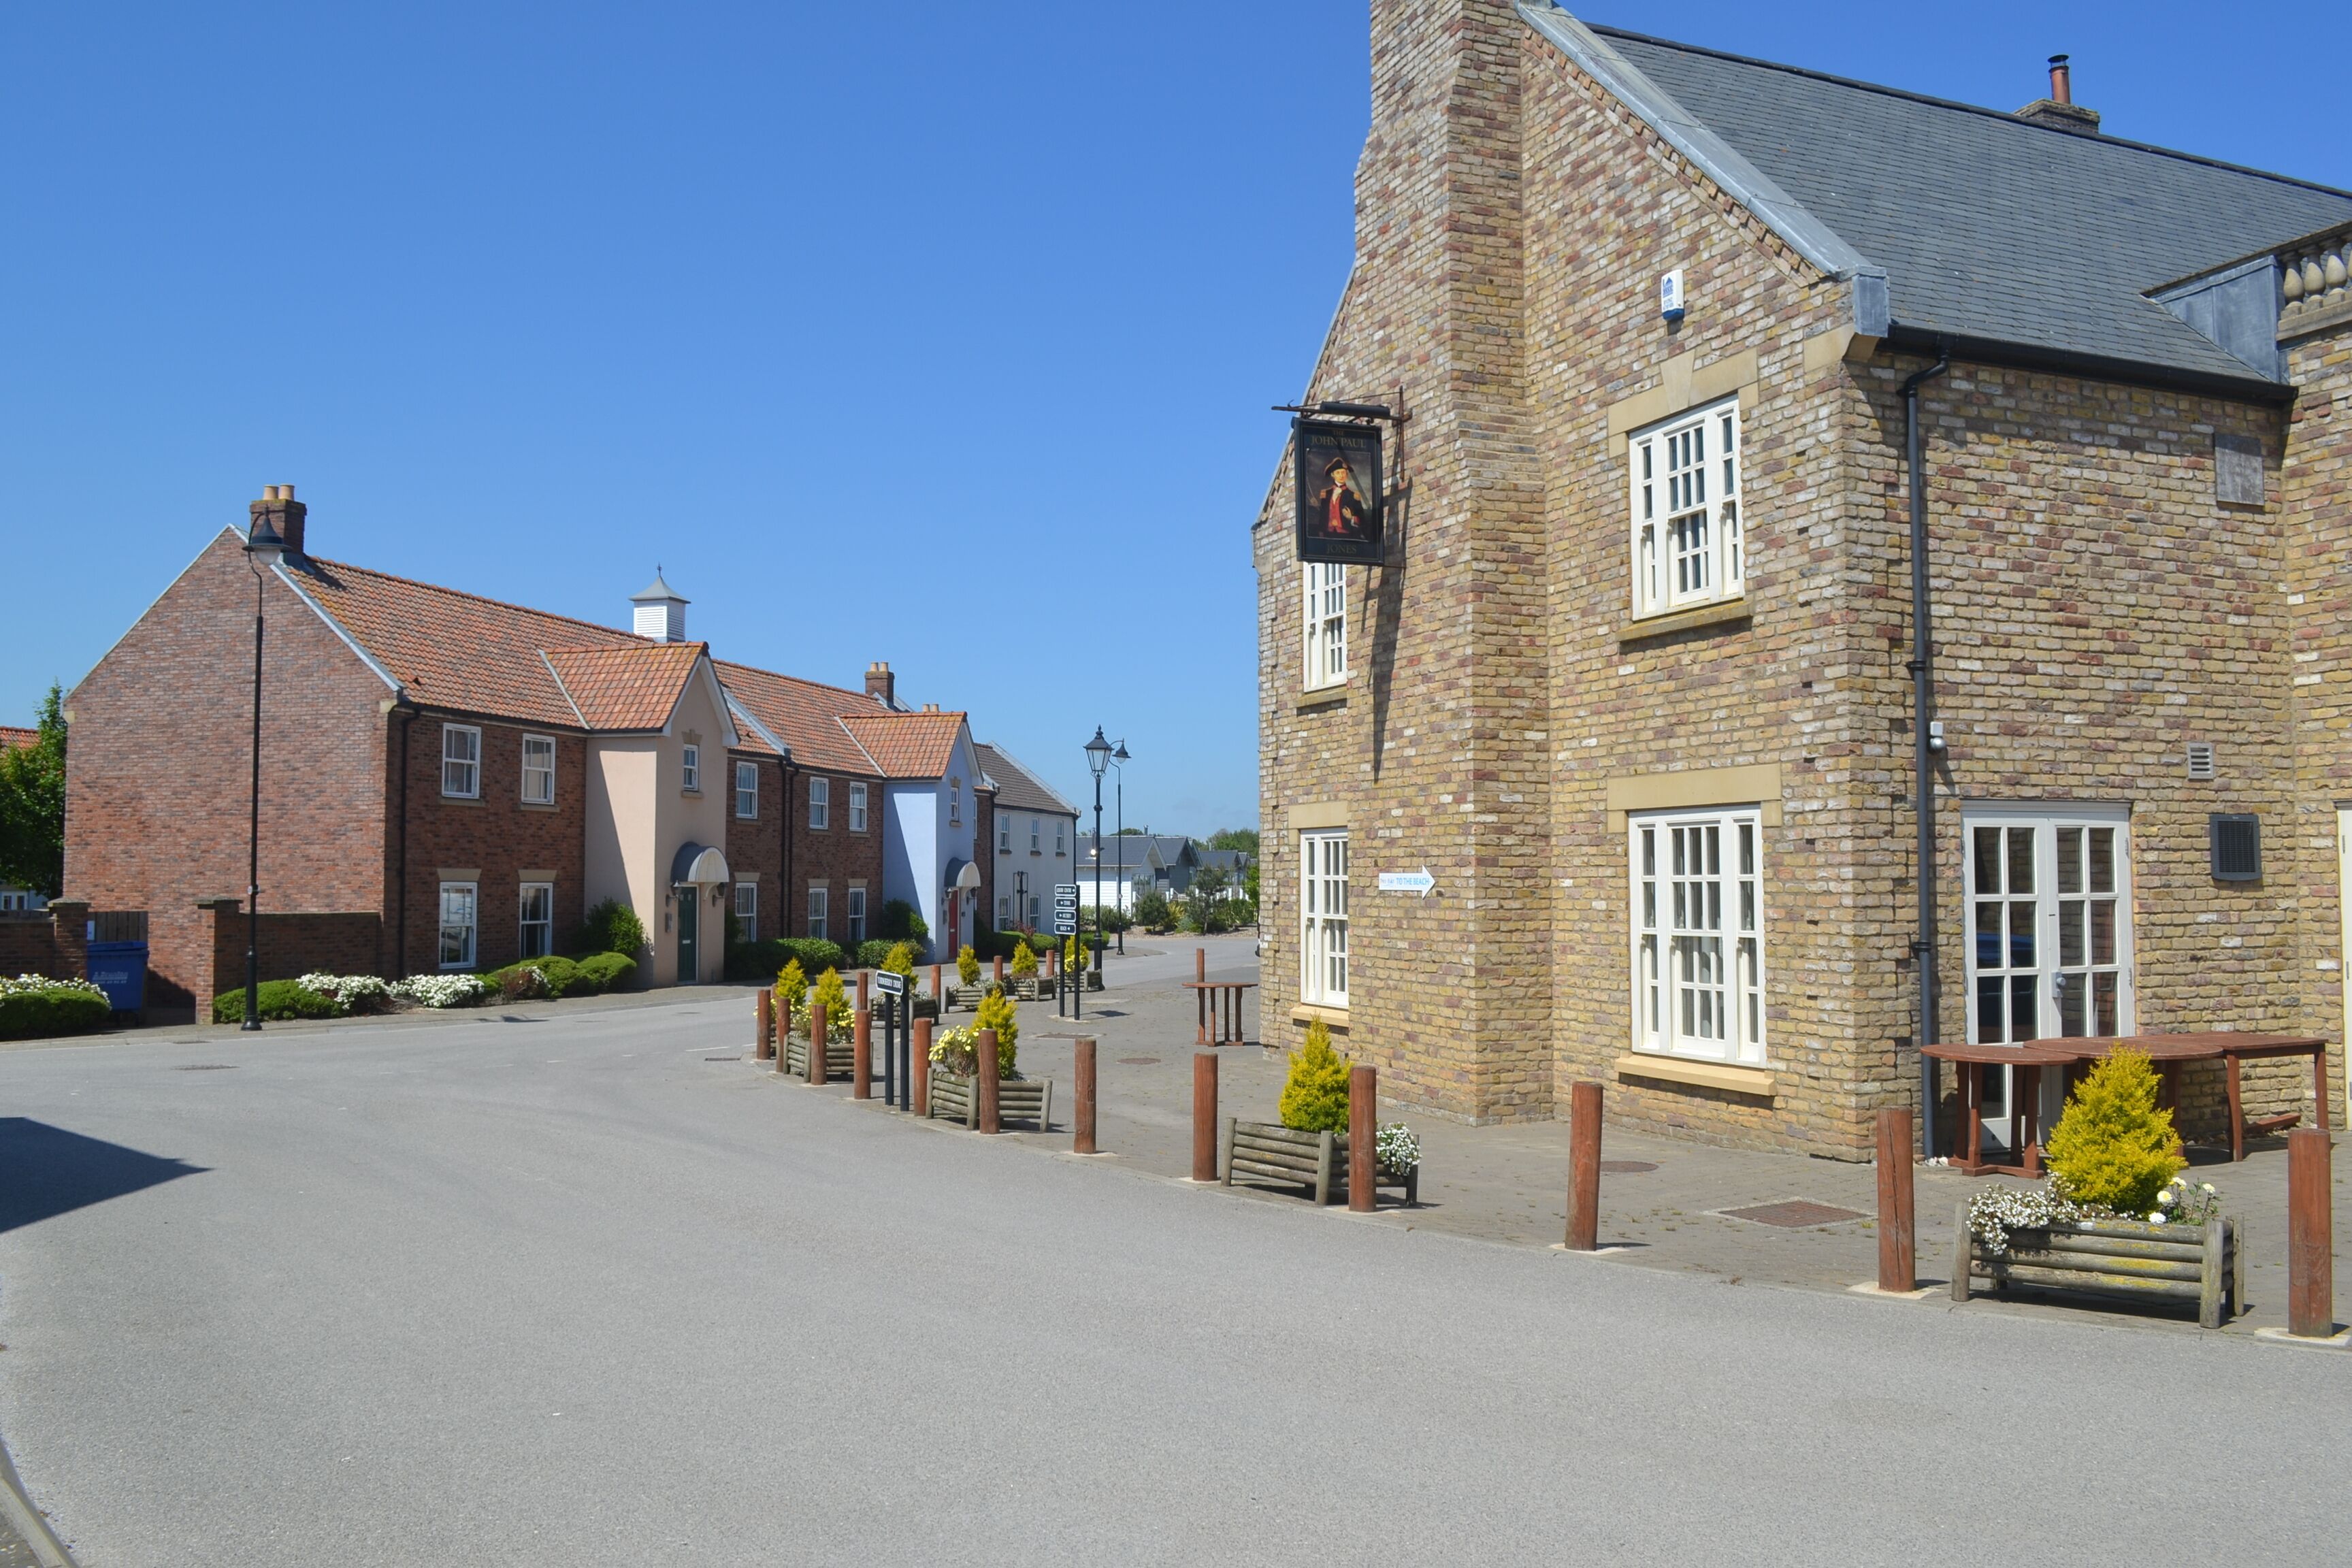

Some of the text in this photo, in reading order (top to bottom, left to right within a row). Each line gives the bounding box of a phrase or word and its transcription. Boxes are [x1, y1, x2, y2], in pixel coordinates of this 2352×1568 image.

[1311, 436, 1367, 448] JOHN PAUL
[1327, 544, 1356, 554] JONES
